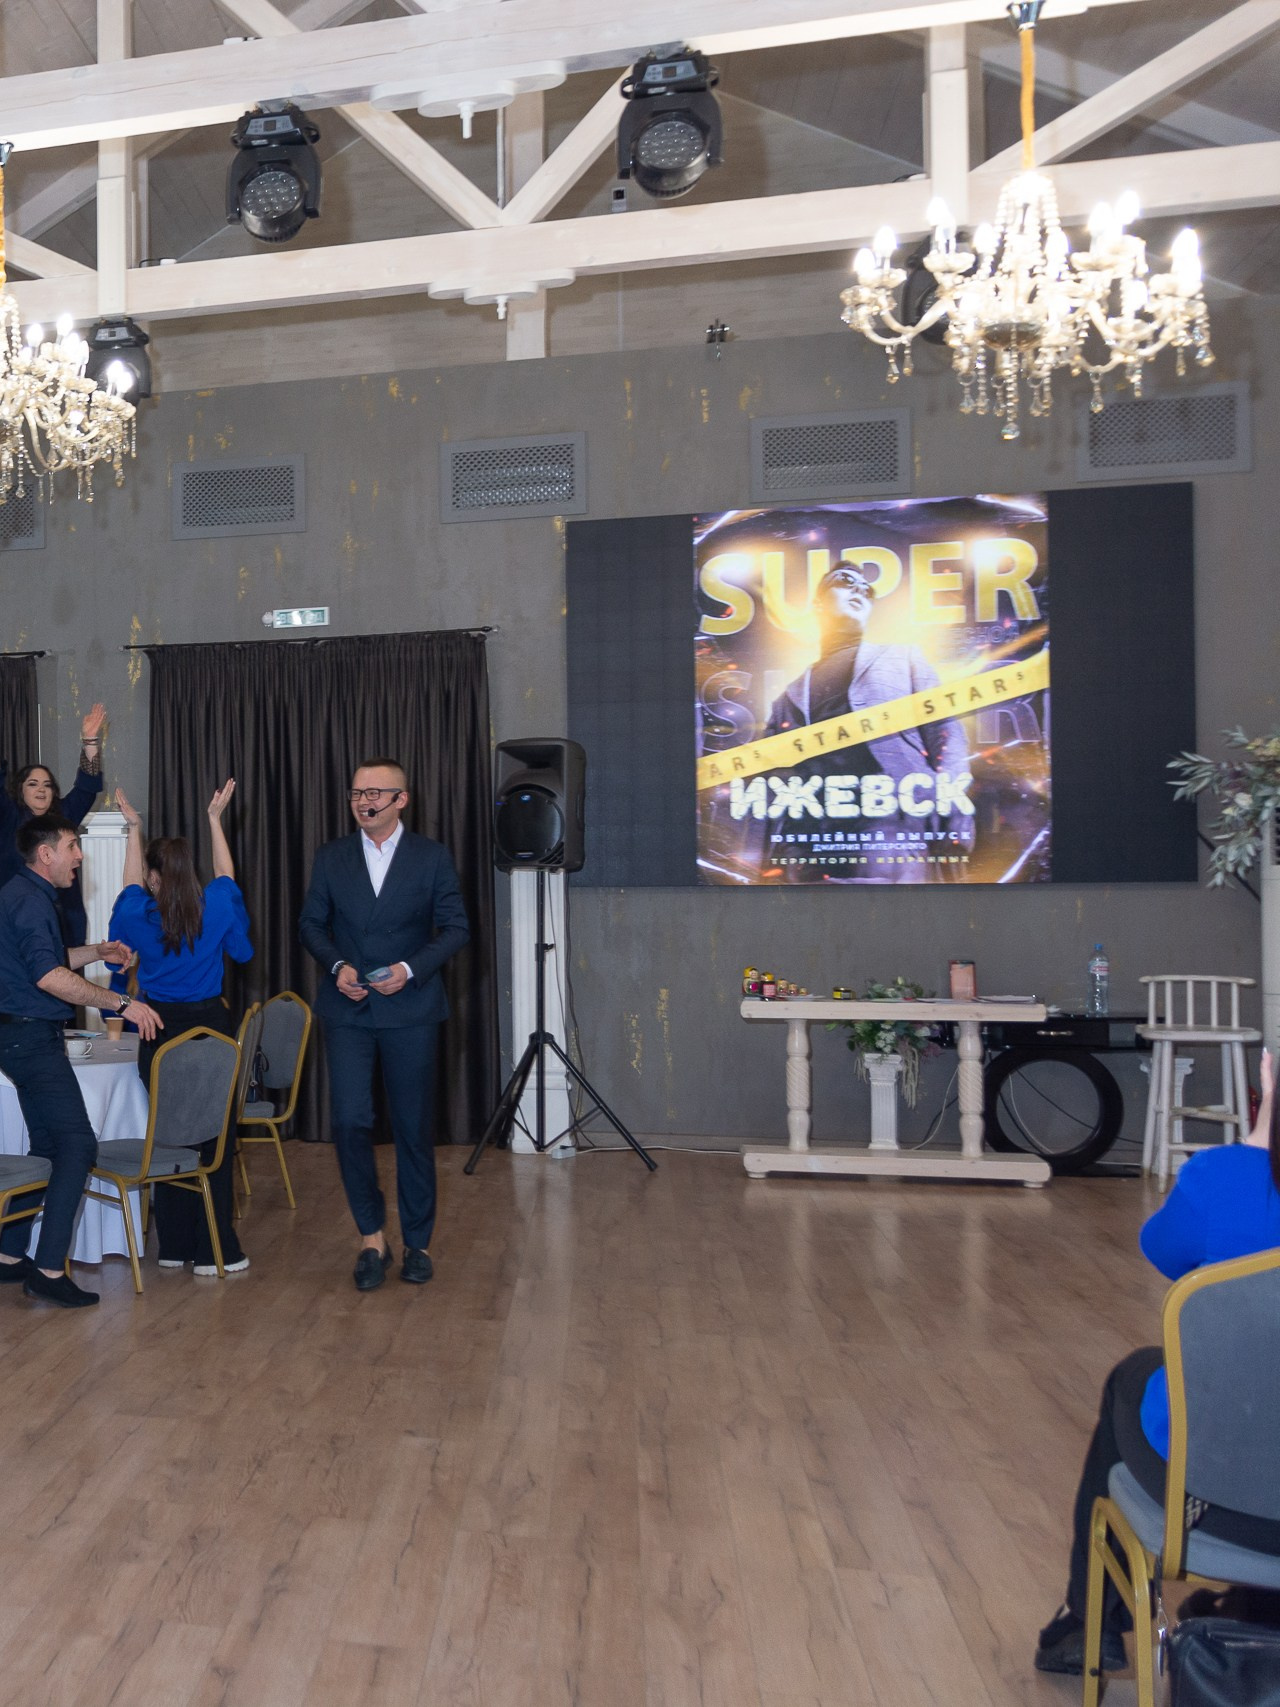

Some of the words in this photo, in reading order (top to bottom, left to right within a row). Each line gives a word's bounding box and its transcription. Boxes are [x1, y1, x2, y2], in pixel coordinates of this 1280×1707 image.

[698, 538, 1041, 643] SUPER
[923, 671, 1024, 715] STARS
[729, 772, 976, 820] ИЖЕВСК
[770, 831, 885, 843] ЮБИЛЕЙНЫЙ
[896, 831, 971, 841] ВЫПУСК
[771, 857, 868, 865] ТЕРРИТОРИЯ
